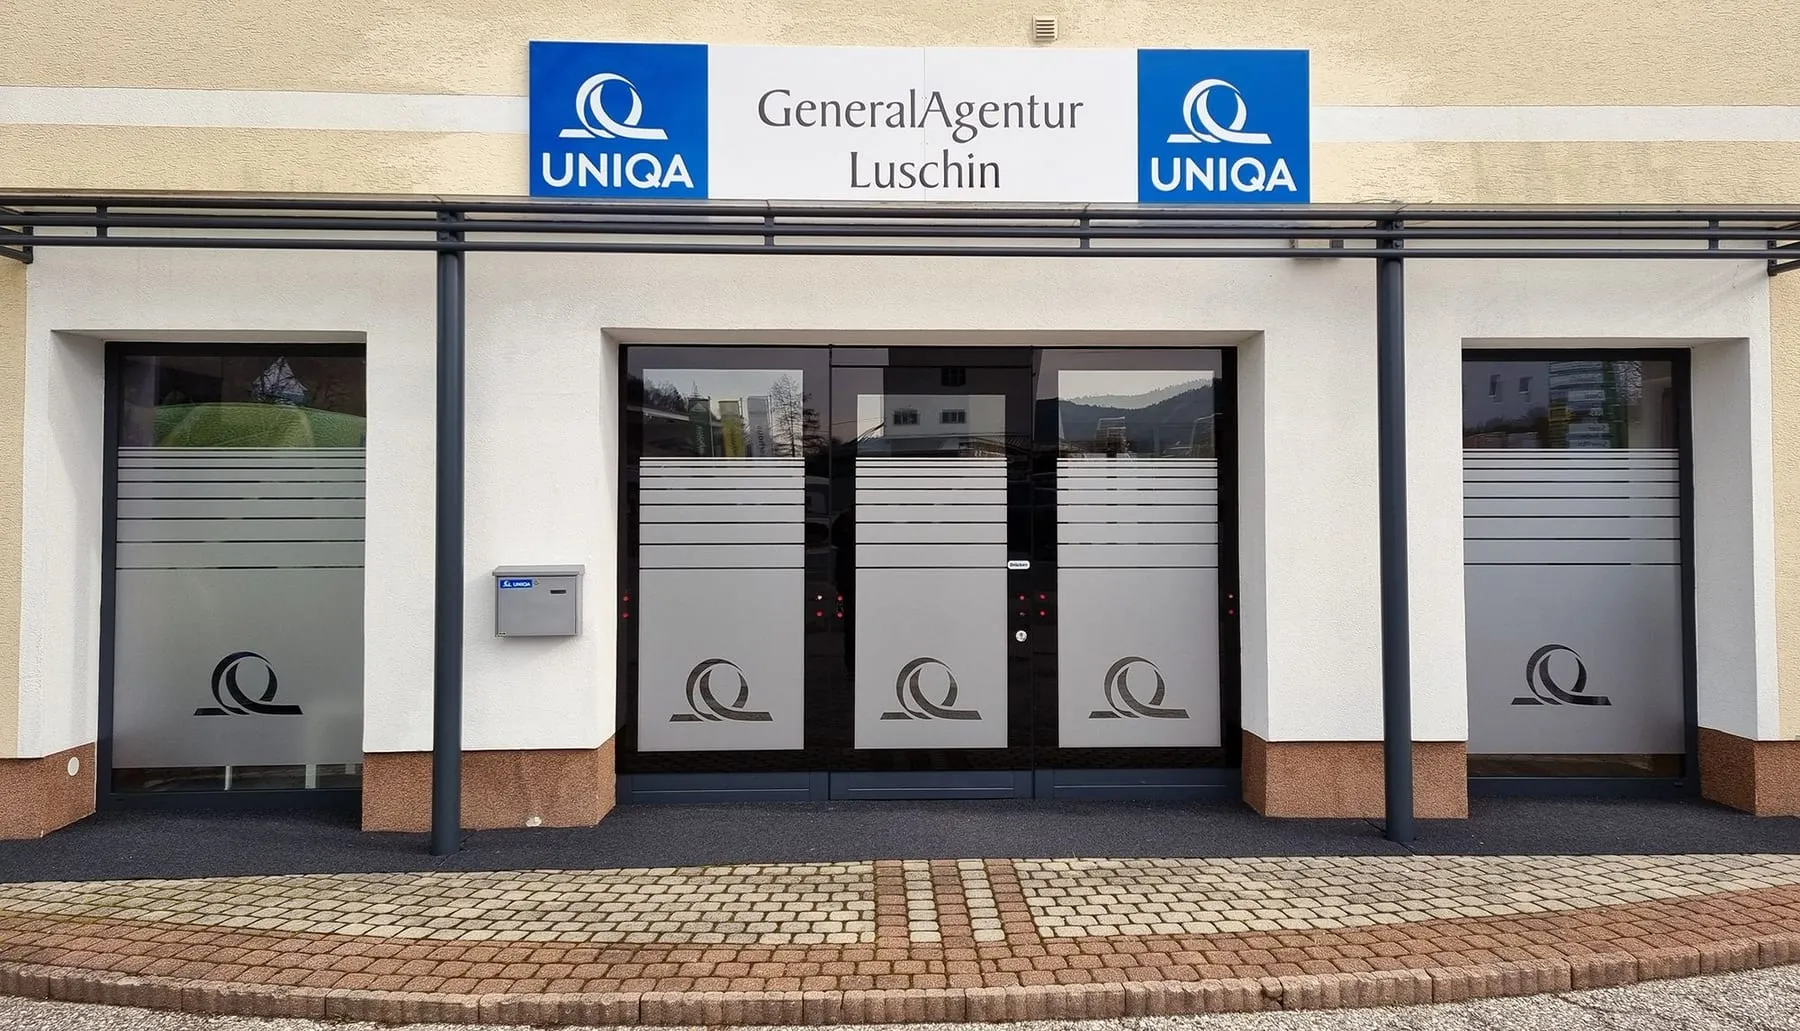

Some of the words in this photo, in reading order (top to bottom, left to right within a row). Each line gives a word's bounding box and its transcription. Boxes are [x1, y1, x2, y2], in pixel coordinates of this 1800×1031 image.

[758, 89, 1084, 143] GeneralAgentur
[543, 153, 694, 189] UNIQA
[849, 149, 1000, 189] Luschin
[1151, 157, 1297, 193] UNIQA
